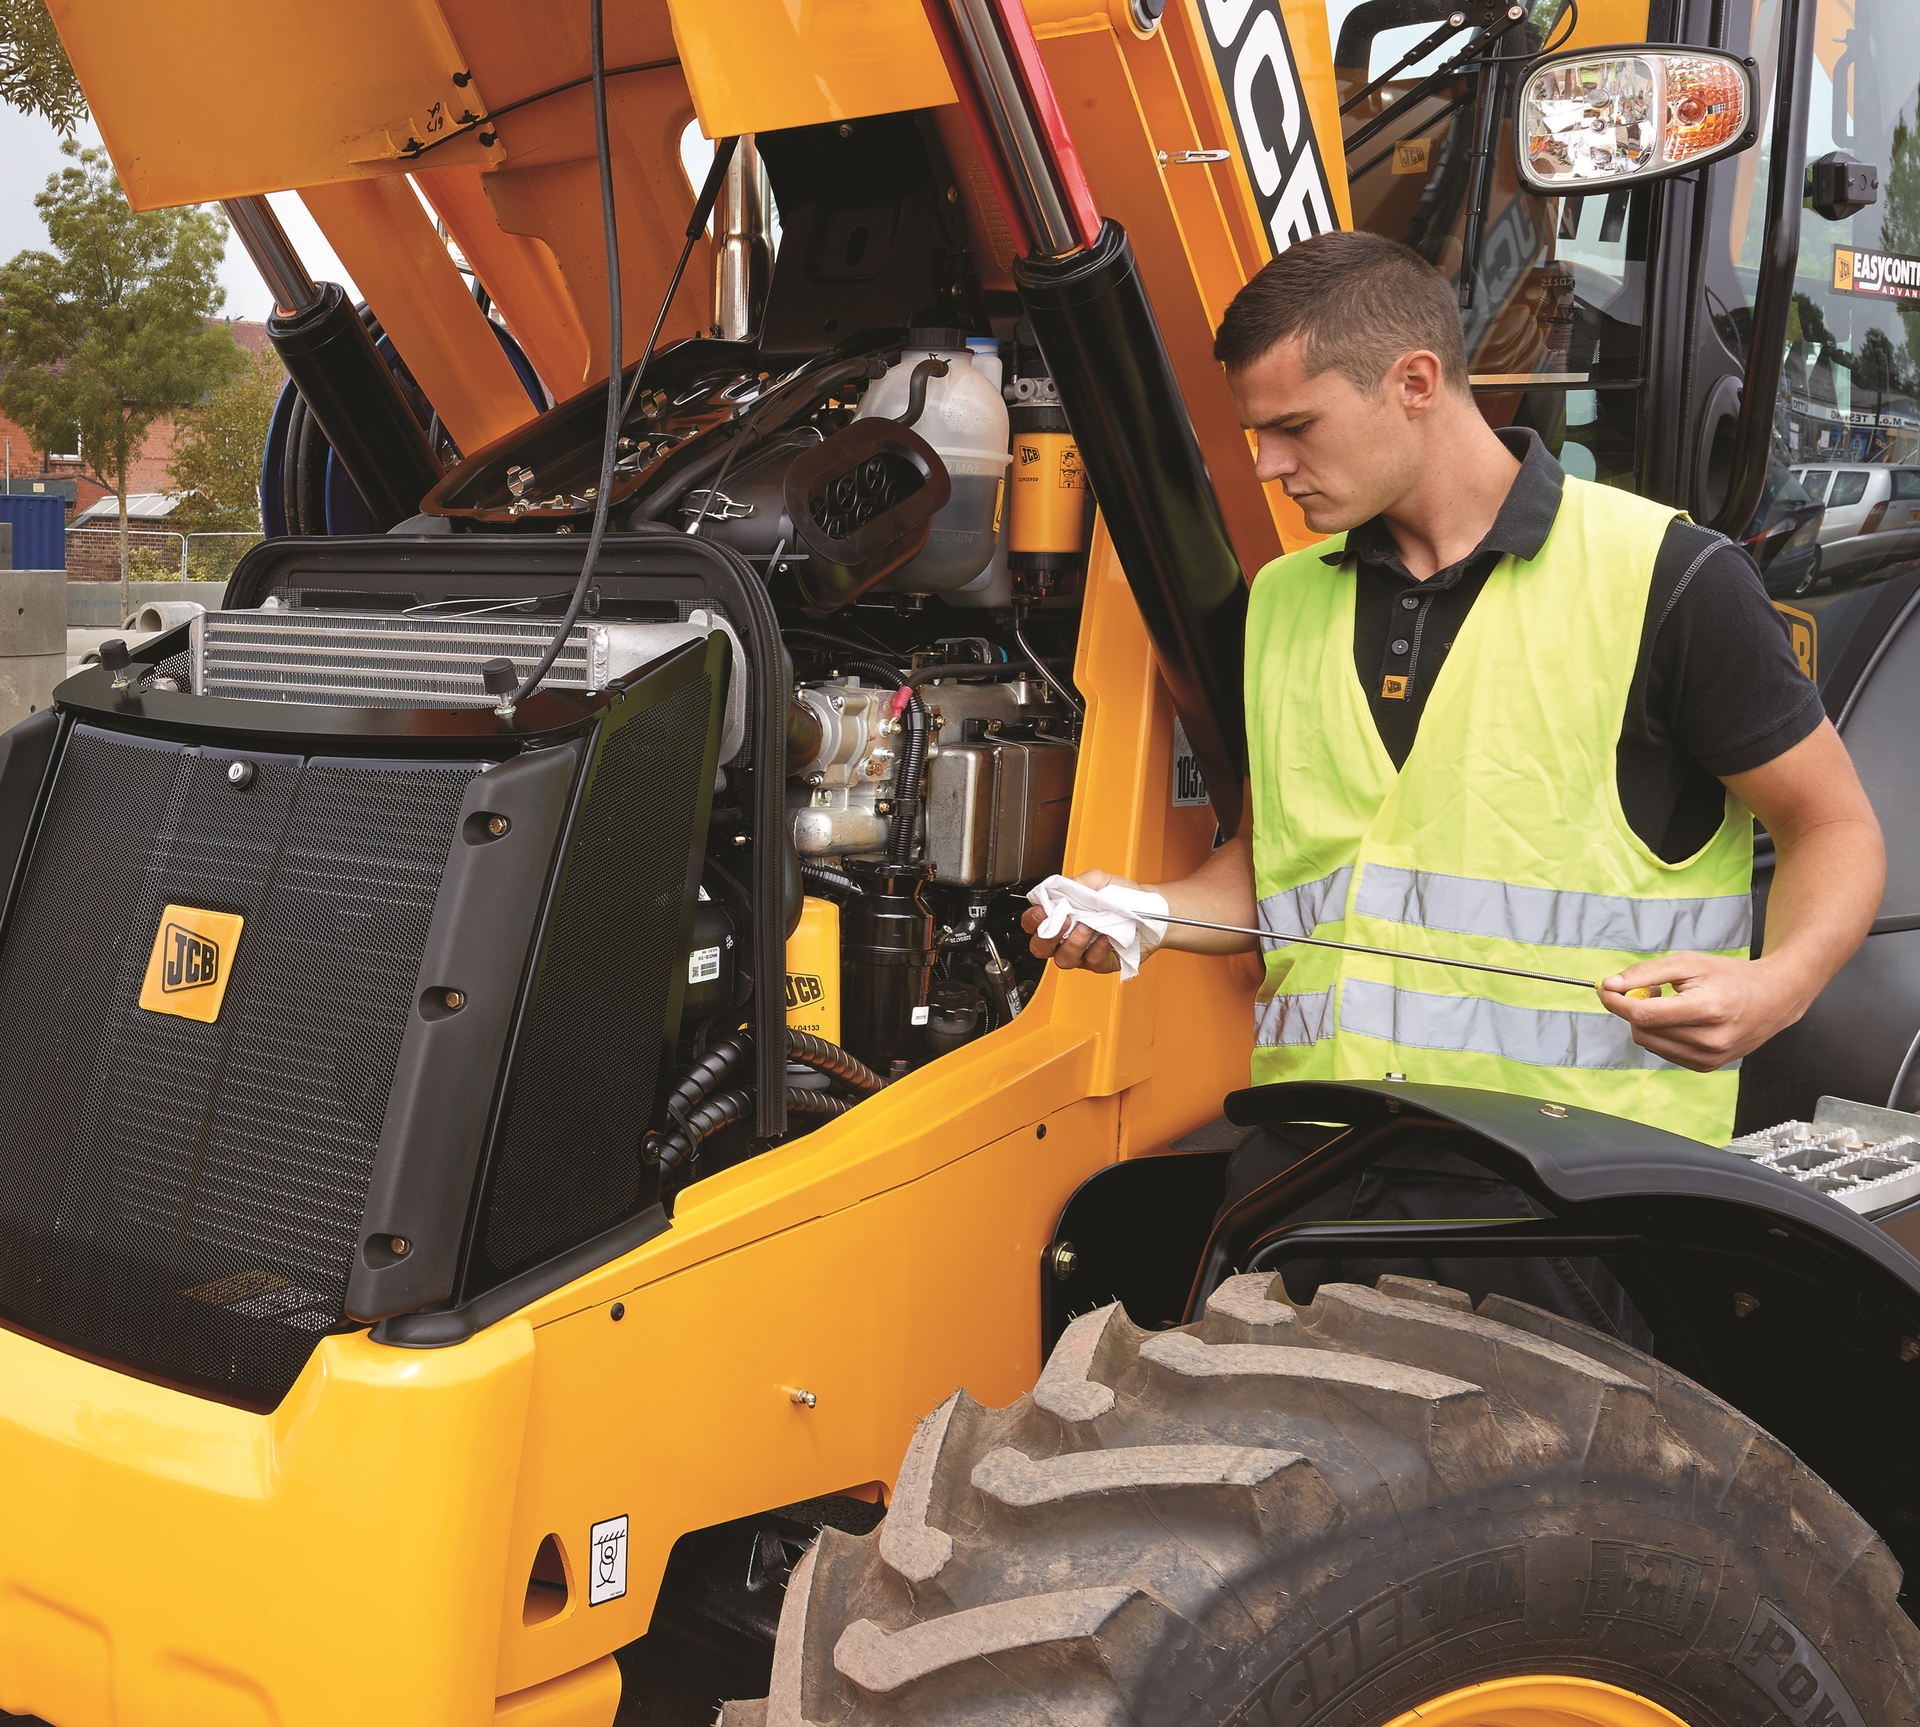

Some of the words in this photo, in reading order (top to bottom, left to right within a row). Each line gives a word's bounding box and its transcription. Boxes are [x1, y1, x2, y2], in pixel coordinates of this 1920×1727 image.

[1401, 148, 1424, 166] JCB
[1839, 260, 1851, 279] JCB
[1853, 252, 1920, 292] EASYCONT
[1022, 447, 1038, 463] JCB
[955, 462, 981, 475] MAX
[167, 931, 216, 987] JCB
